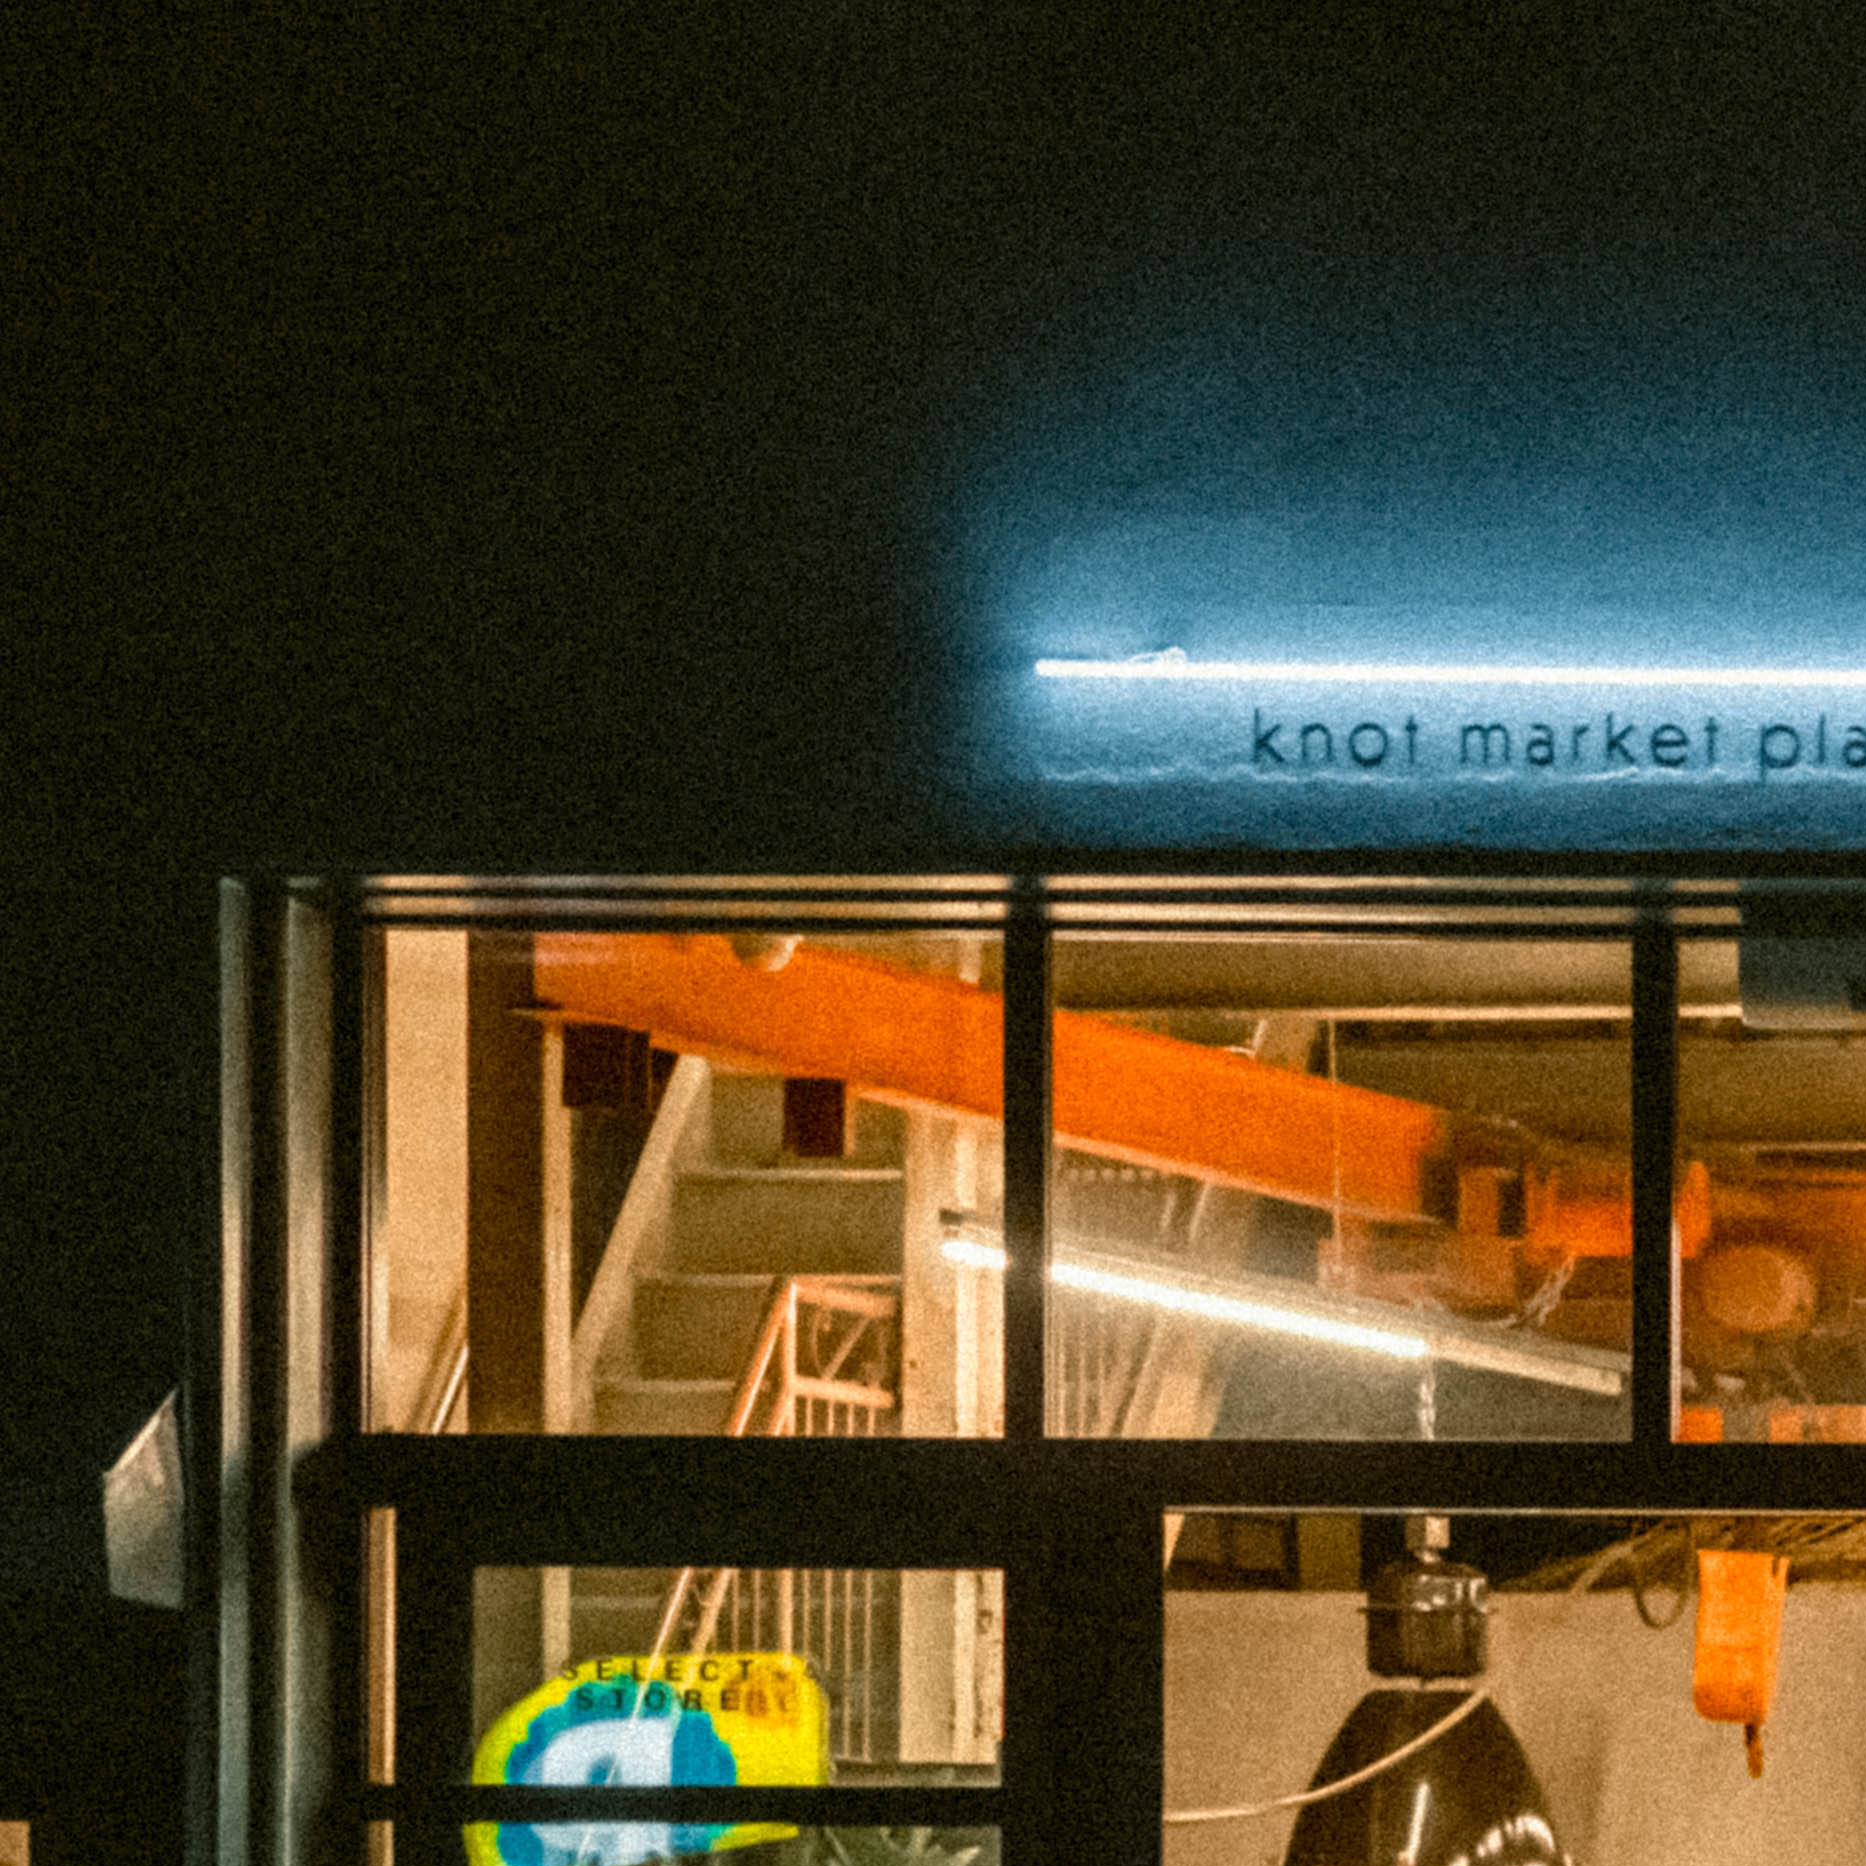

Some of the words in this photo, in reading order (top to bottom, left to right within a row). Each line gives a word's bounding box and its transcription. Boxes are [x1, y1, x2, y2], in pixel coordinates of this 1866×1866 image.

[1253, 707, 1420, 768] knot
[1459, 711, 1719, 767] market
[561, 1659, 754, 1682] SELECT
[575, 1688, 740, 1713] STORE
